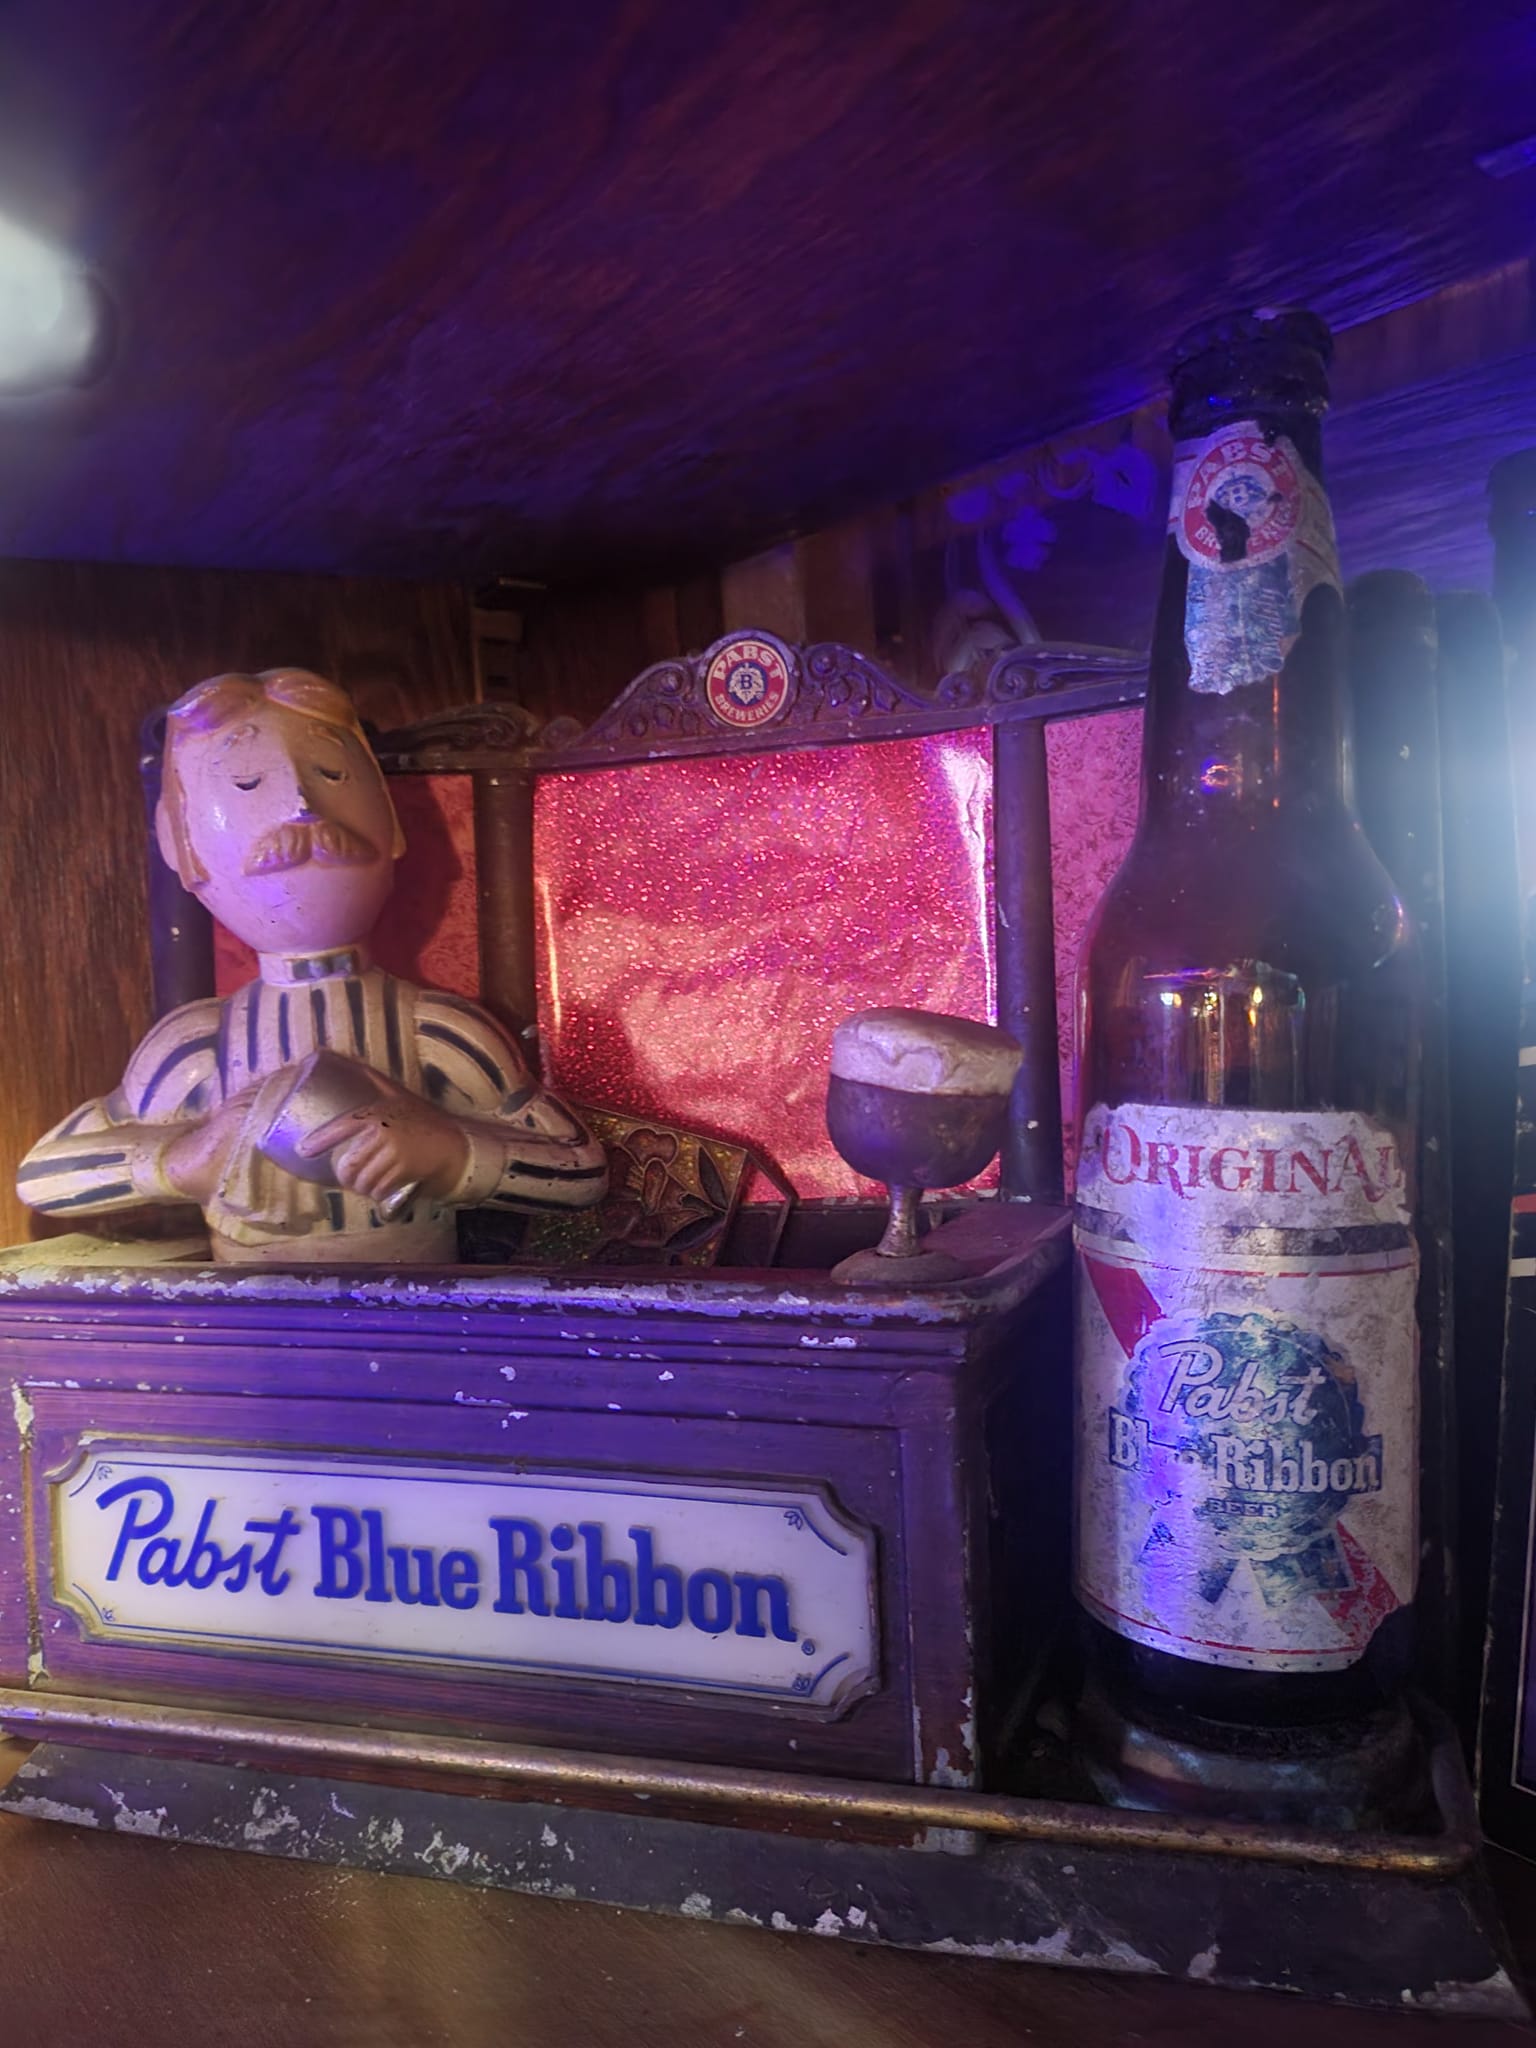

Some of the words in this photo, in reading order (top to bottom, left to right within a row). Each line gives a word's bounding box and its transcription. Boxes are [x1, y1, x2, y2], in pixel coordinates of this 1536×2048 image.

[1187, 441, 1290, 508] PABST
[713, 646, 783, 680] PABST
[740, 674, 753, 690] B
[715, 692, 779, 721] BREWERIES
[1102, 1124, 1402, 1203] ORIGINAL
[1158, 1339, 1326, 1425] Pabst
[1211, 1434, 1380, 1493] Ribbon
[1206, 1499, 1279, 1517] BEER
[97, 1476, 300, 1596] Pabst
[311, 1505, 482, 1610] Blue
[488, 1516, 798, 1643] Ribbon
